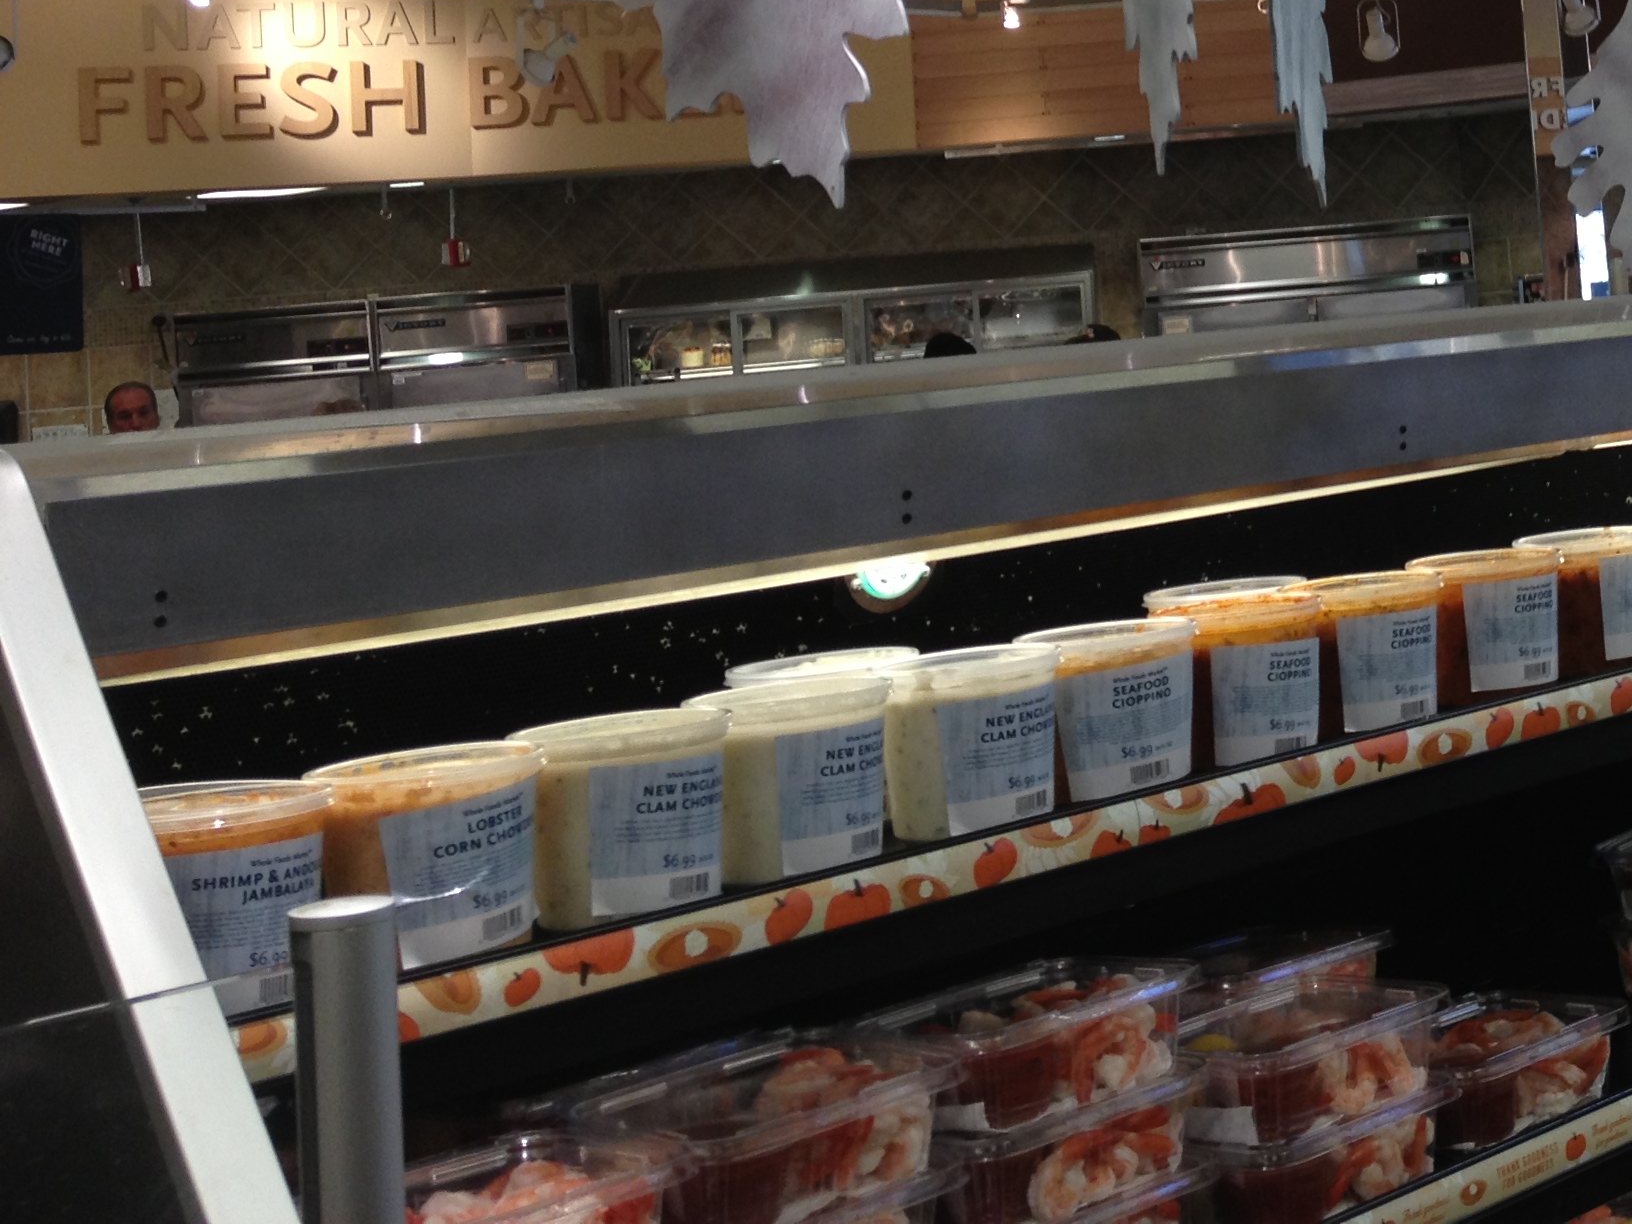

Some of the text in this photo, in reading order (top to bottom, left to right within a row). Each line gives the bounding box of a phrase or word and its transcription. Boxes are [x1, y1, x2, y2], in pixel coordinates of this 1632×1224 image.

[143, 1, 663, 52] NATURAL ARTISA
[78, 49, 746, 147] FRESH BAK
[30, 229, 69, 247] RIGHT
[31, 240, 63, 257] HERE
[1516, 590, 1553, 603] SEAFOOD
[1269, 656, 1311, 670] SEAFOOD
[1112, 676, 1169, 697] SEAFOOD
[1112, 687, 1172, 709] CIOPPINO
[985, 714, 1016, 727] NEW
[980, 729, 1017, 744] CLAM
[826, 747, 855, 760] NEW
[820, 762, 856, 777] CLAM
[643, 783, 678, 797] NEW
[636, 801, 678, 814] CLAM
[468, 805, 522, 833] LOBSTER
[433, 838, 482, 859] CORN
[191, 873, 263, 892] SHRIMP
[268, 869, 279, 883] &
